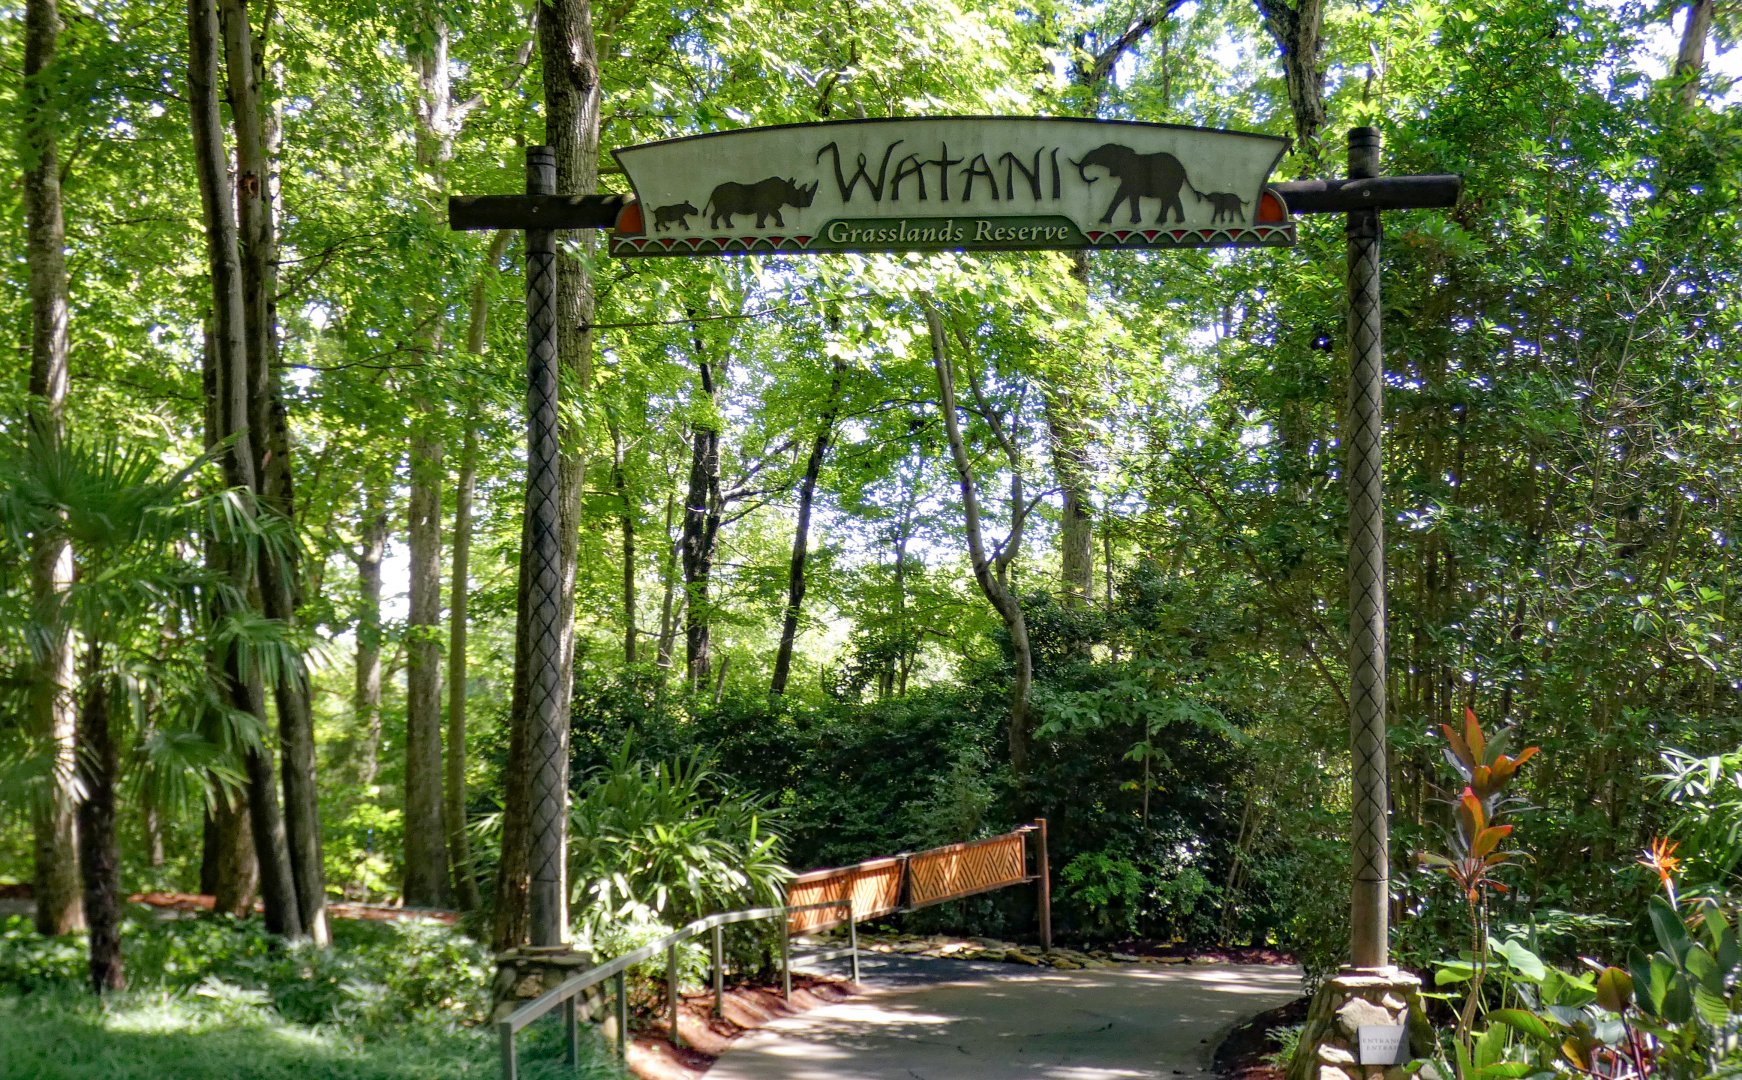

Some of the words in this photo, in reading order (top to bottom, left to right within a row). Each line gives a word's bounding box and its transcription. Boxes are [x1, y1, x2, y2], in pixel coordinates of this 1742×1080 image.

[816, 139, 1060, 202] WATANI
[827, 220, 964, 243] Grasslands
[973, 220, 1069, 241] Reserve
